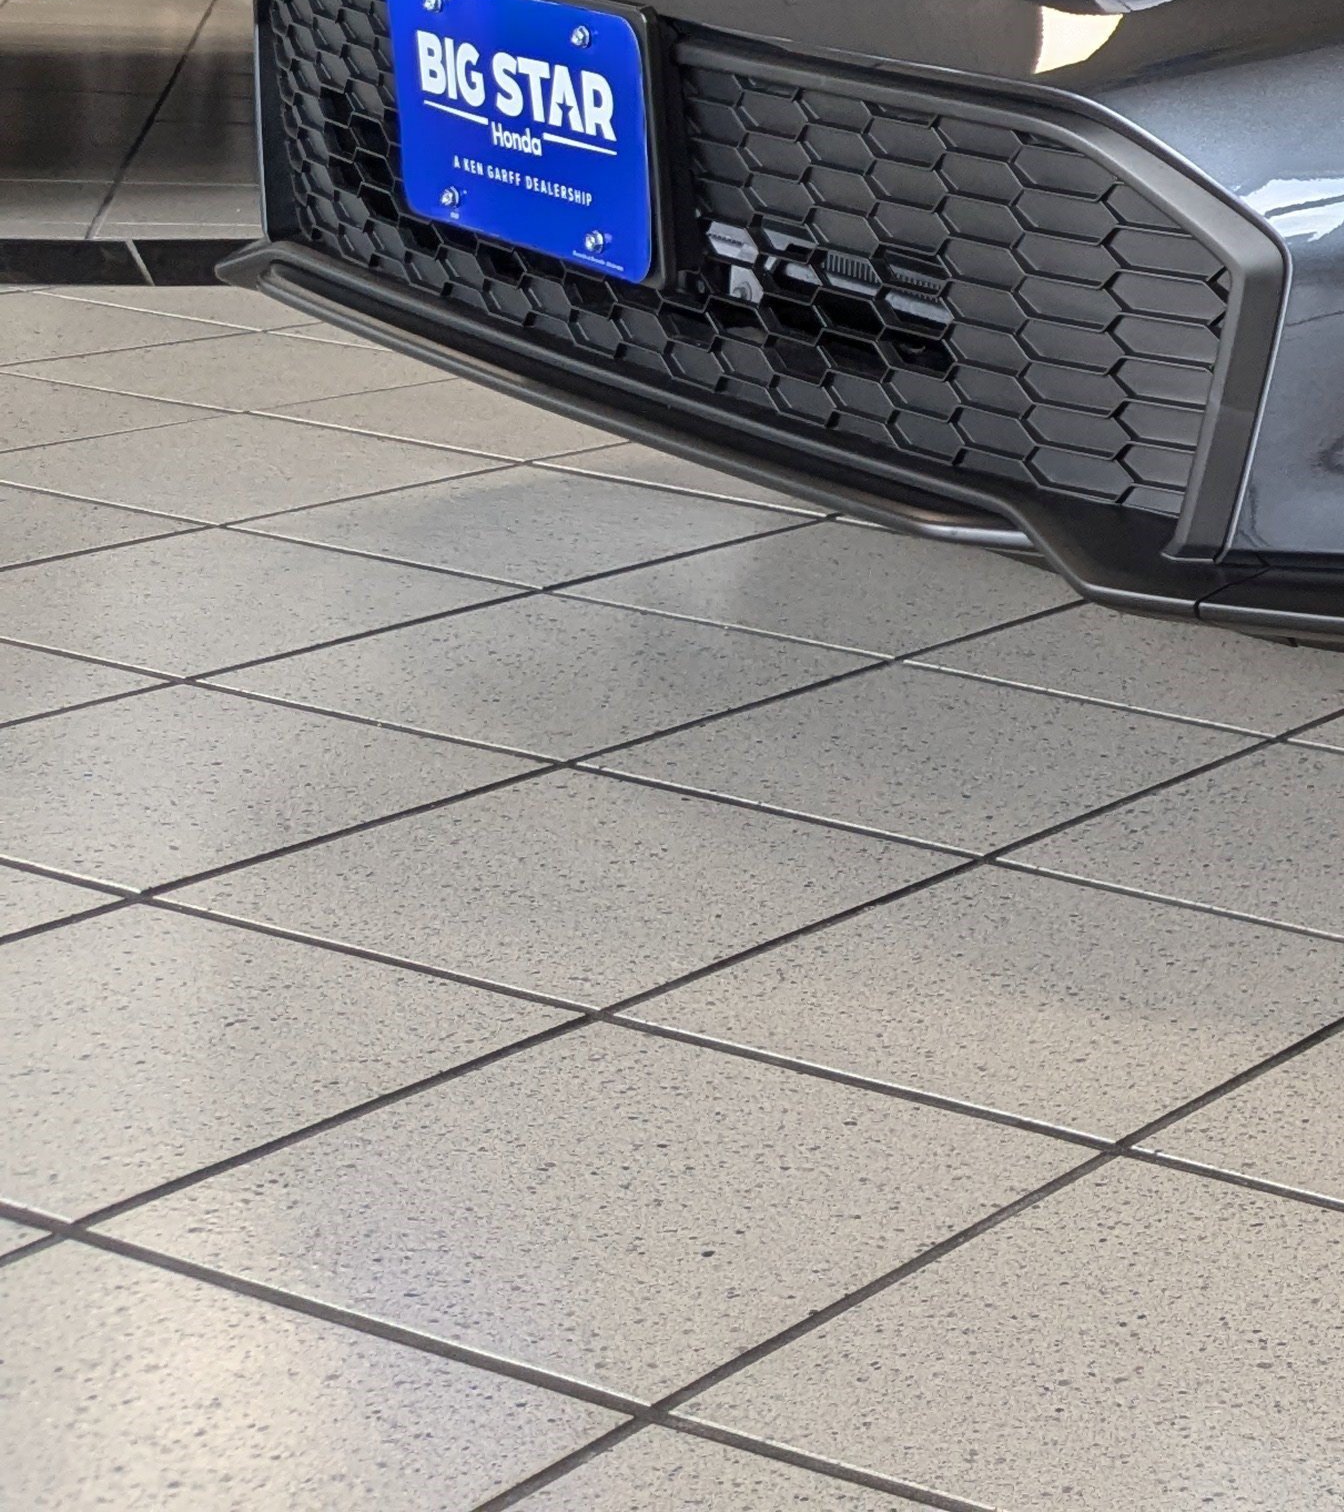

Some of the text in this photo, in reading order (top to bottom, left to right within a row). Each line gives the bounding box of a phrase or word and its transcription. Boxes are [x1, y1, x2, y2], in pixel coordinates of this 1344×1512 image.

[416, 30, 617, 142] BIG STAR
[491, 121, 543, 157] Honda
[453, 155, 593, 207] A KEN GARFF DEALERSHIP
